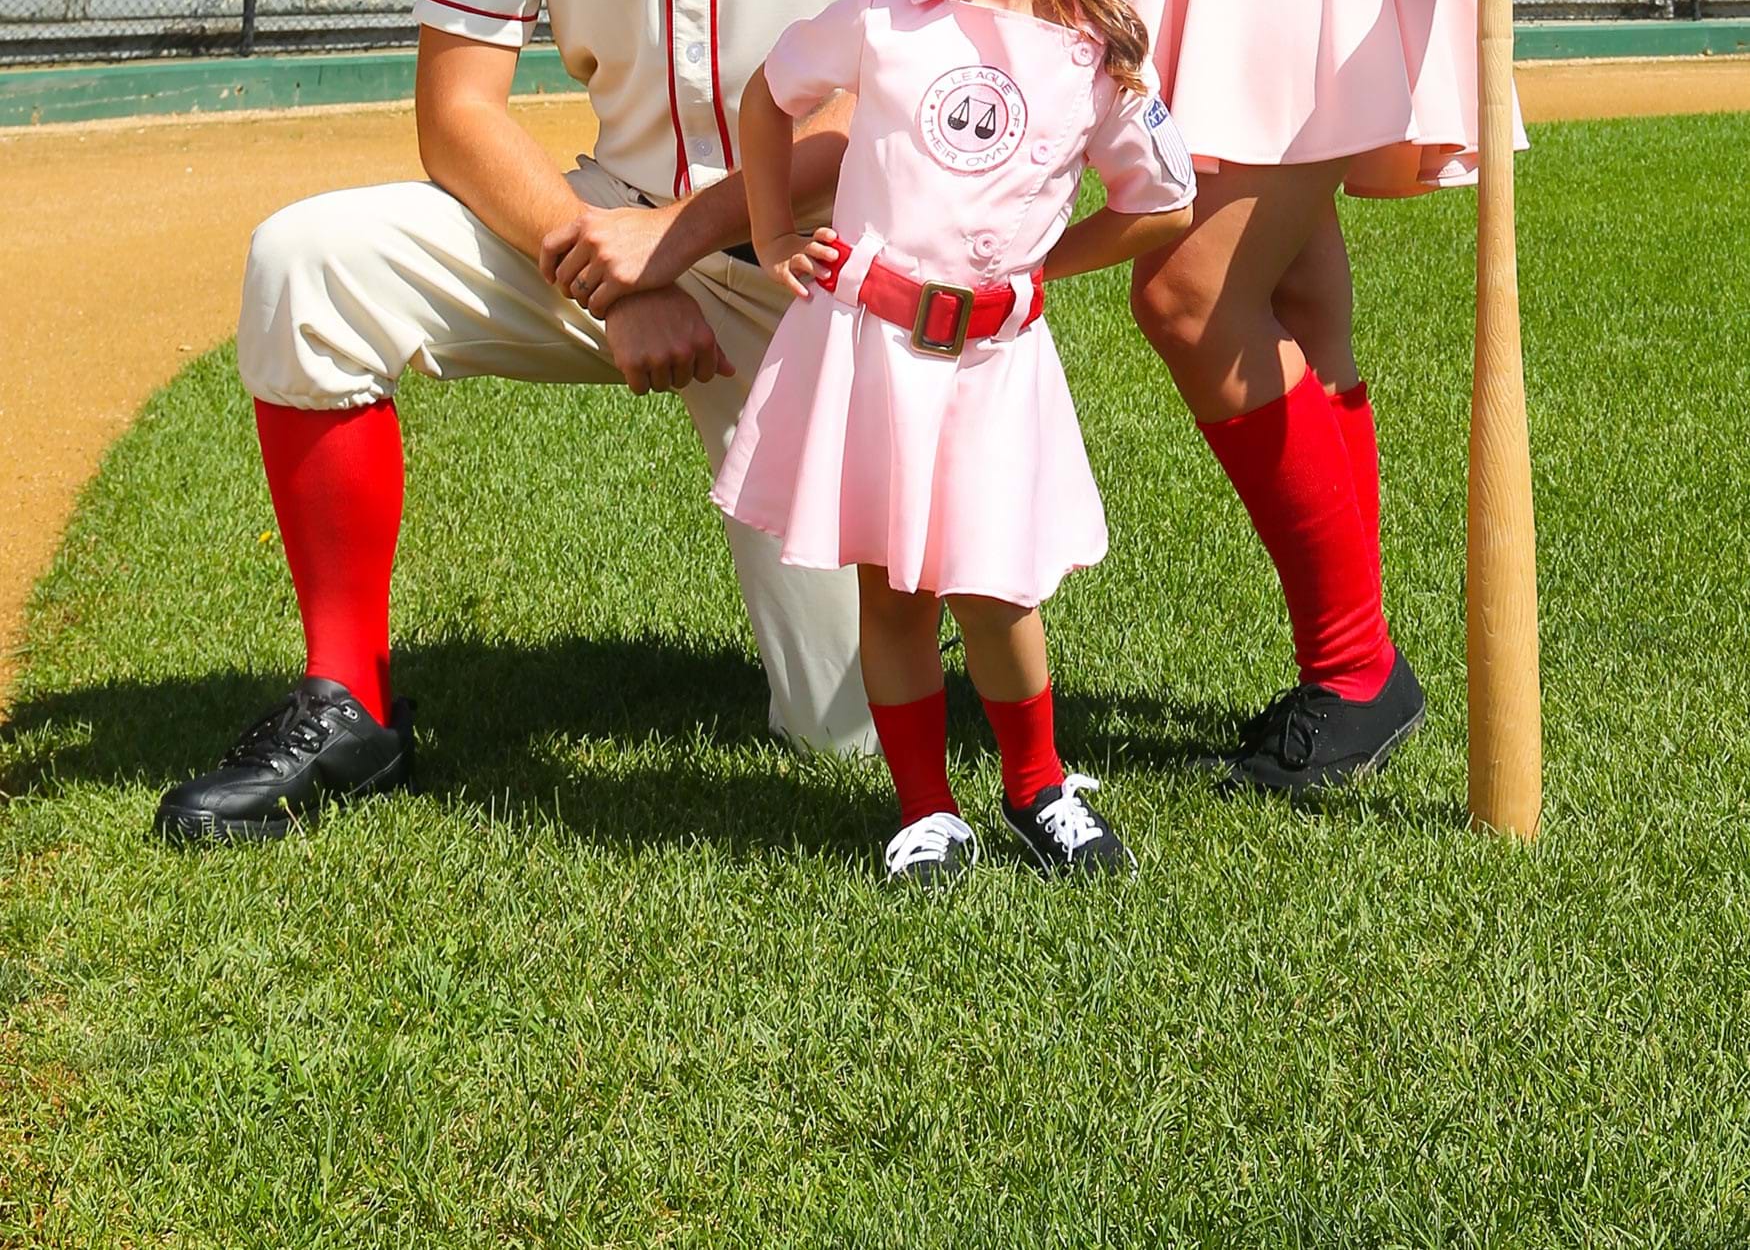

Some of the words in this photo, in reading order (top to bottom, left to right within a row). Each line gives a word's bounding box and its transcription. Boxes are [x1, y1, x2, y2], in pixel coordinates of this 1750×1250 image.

[934, 88, 944, 99] A
[951, 71, 1013, 96] LEAGUE
[1010, 102, 1021, 128] OF
[924, 116, 958, 164] THEIR
[966, 142, 1009, 167] OWN
